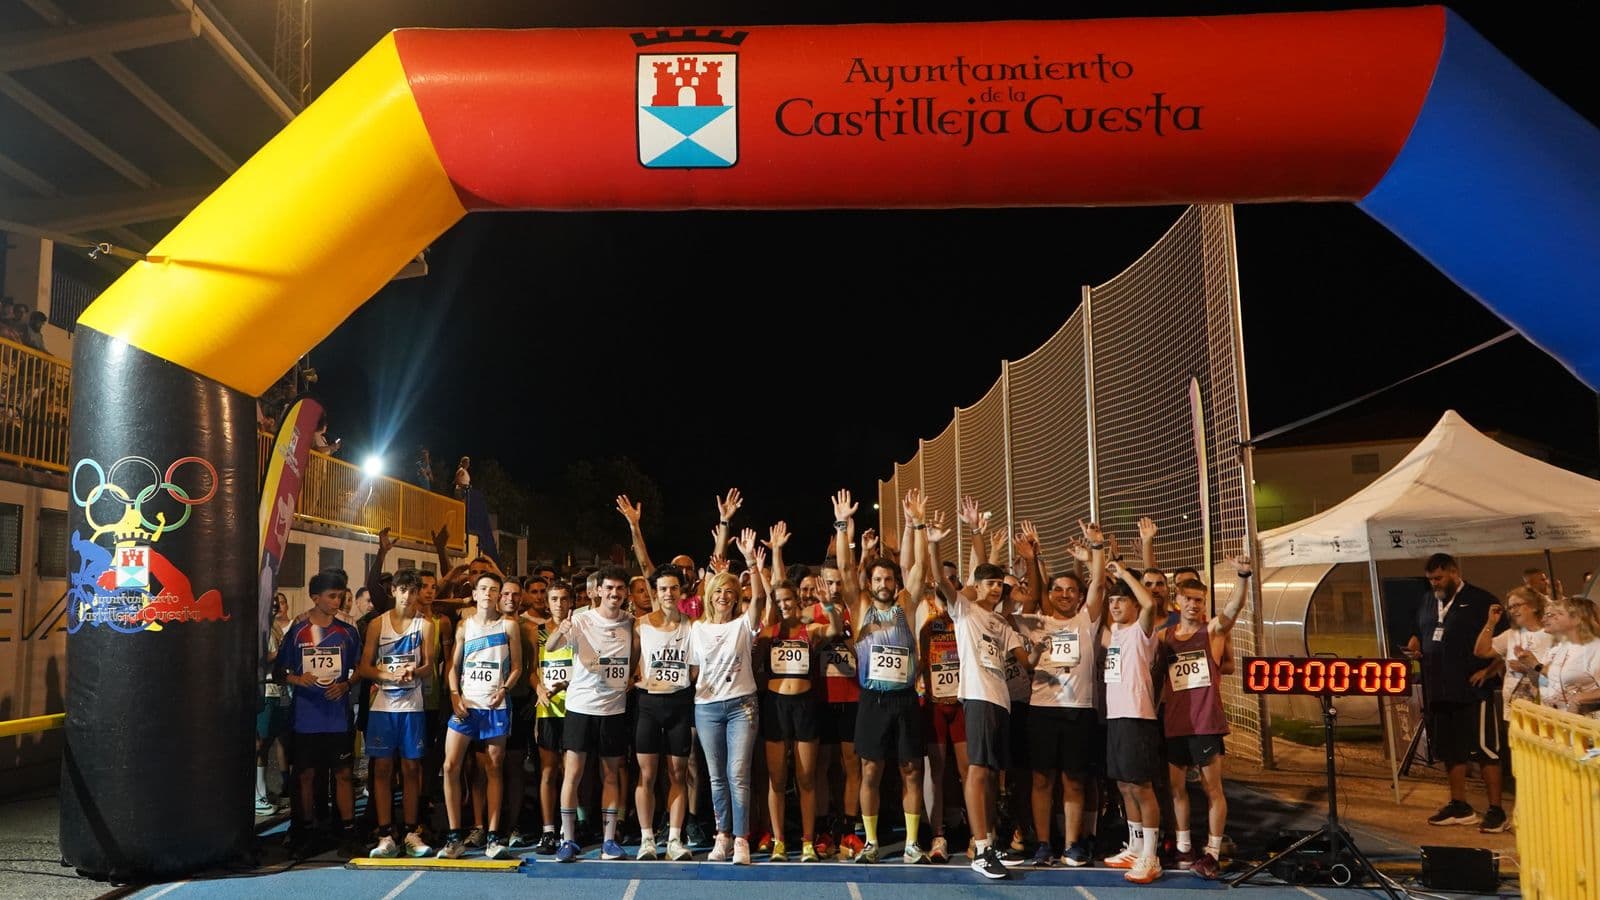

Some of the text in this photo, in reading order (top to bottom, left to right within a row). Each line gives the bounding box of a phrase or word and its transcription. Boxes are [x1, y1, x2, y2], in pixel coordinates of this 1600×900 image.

[842, 53, 1134, 92] Ayuntamiento
[980, 86, 1026, 103] de la
[774, 92, 1205, 147] Castilleja Cuesta
[778, 650, 802, 662] 290
[877, 656, 902, 669] 293
[310, 657, 334, 669] 173
[1175, 662, 1200, 677] 208
[470, 670, 492, 682] 446
[545, 669, 567, 681] 420
[605, 667, 625, 679] 189
[655, 669, 679, 682] 359
